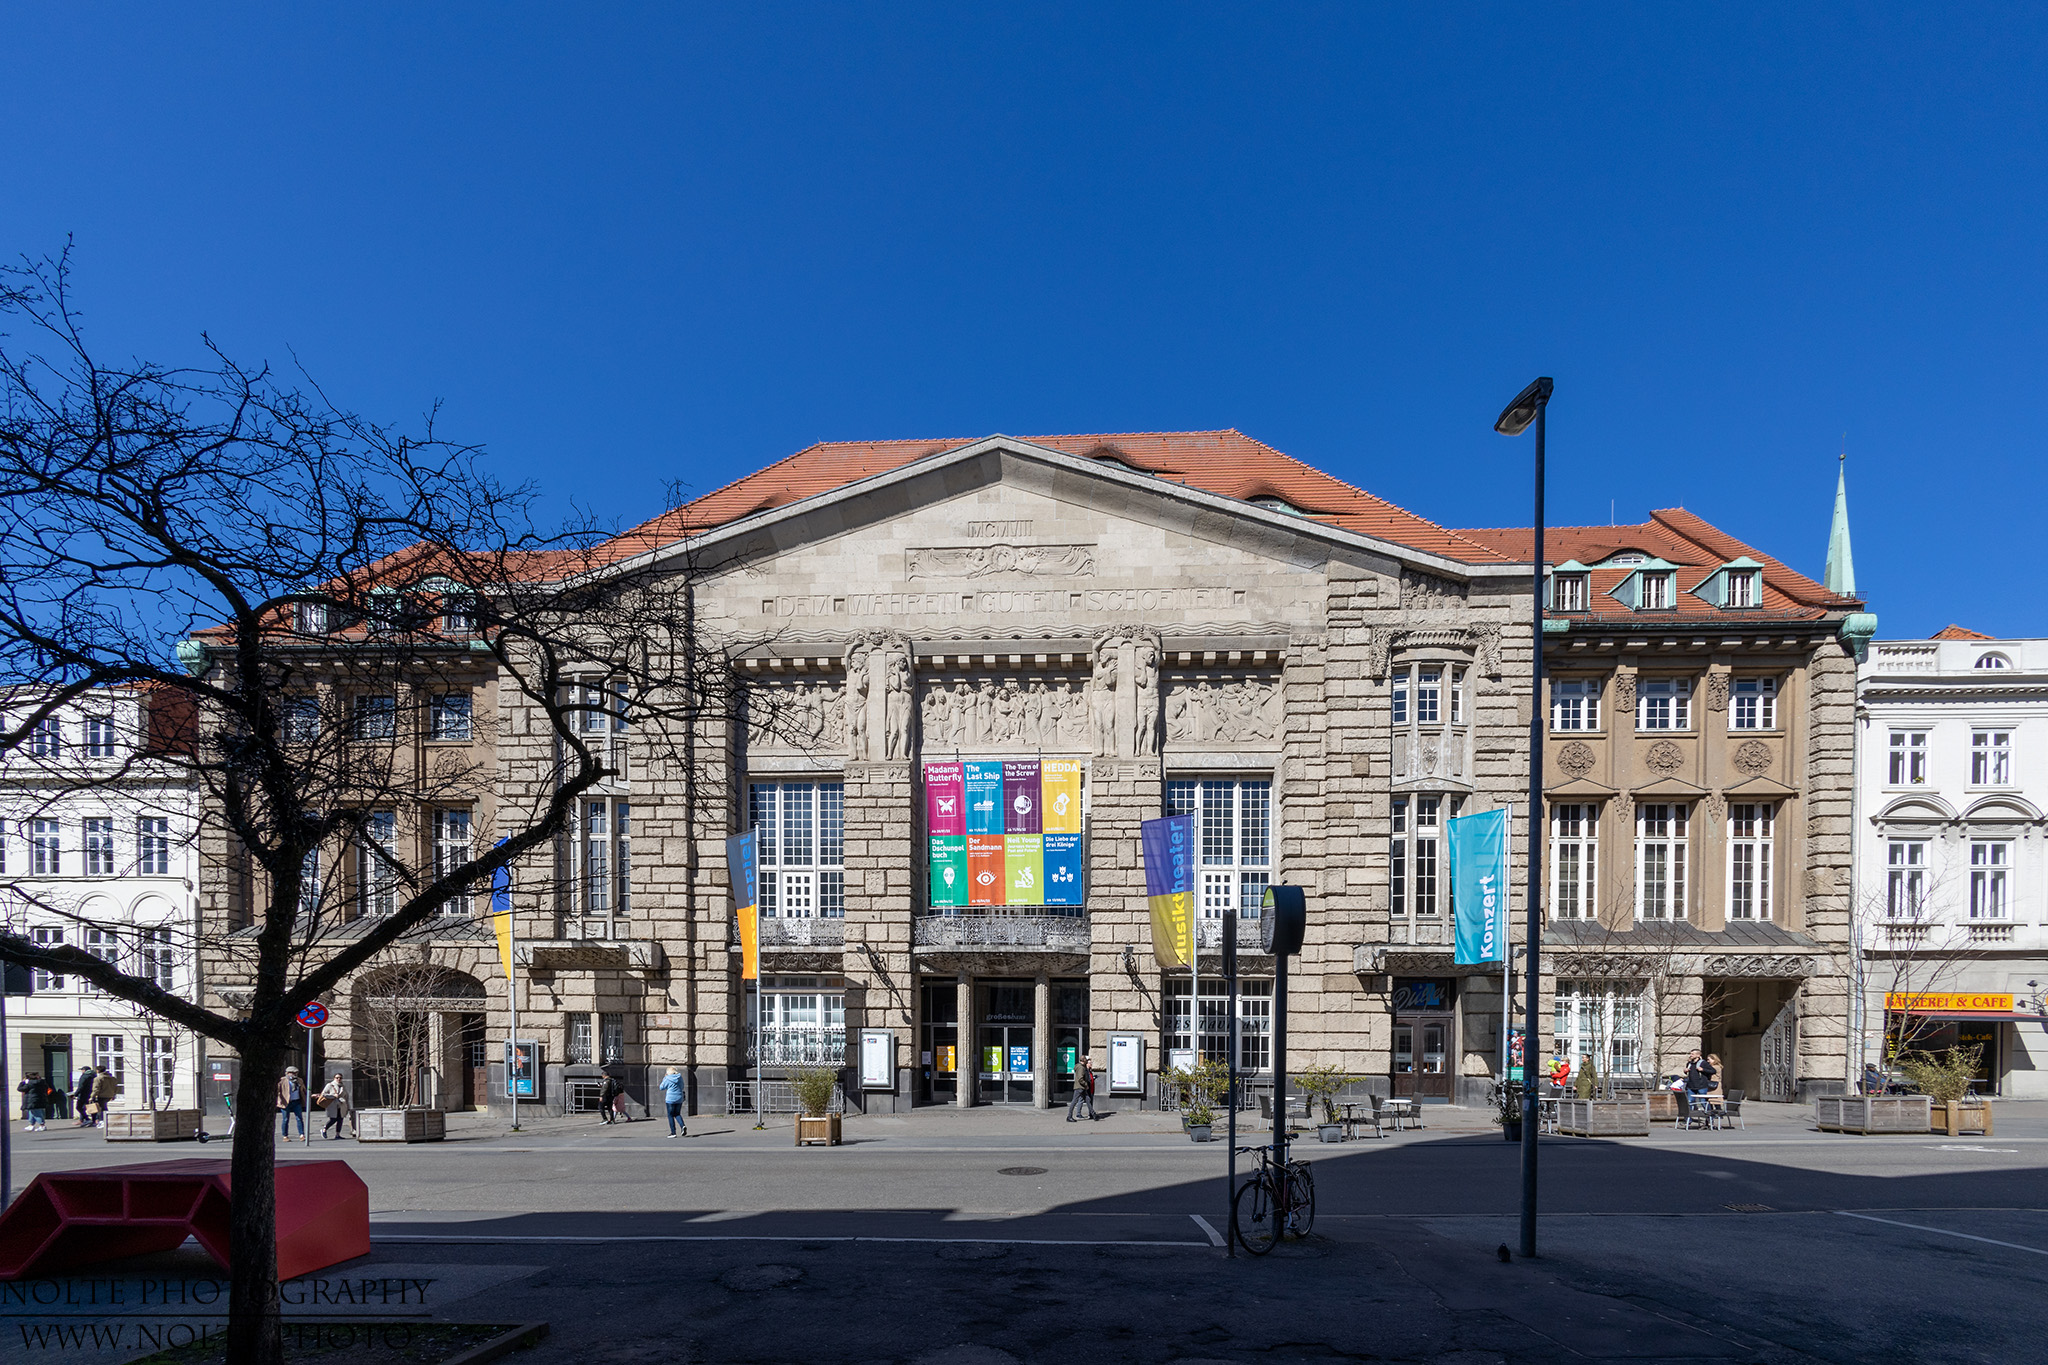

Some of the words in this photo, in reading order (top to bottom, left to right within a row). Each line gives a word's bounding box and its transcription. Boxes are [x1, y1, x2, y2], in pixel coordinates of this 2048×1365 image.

[970, 521, 1032, 538] MCMVIII
[780, 595, 831, 617] DEM
[849, 593, 958, 615] WAHREN
[979, 591, 1068, 613] GUTEN
[1087, 588, 1231, 611] SCHOENEN
[927, 765, 959, 774] Madame
[966, 764, 980, 772] The
[1044, 763, 1078, 773] HEDDA
[928, 773, 962, 782] Butterfly
[983, 772, 1000, 781] Ship
[1021, 837, 1041, 845] Young
[931, 845, 965, 853] Dschungel
[1169, 820, 1187, 966] Musiktheater
[1480, 874, 1496, 958] Konzert
[1956, 996, 1968, 1008] &
[1972, 996, 2008, 1008] CAFE
[1164, 1019, 1270, 1030] RESTAUANT
